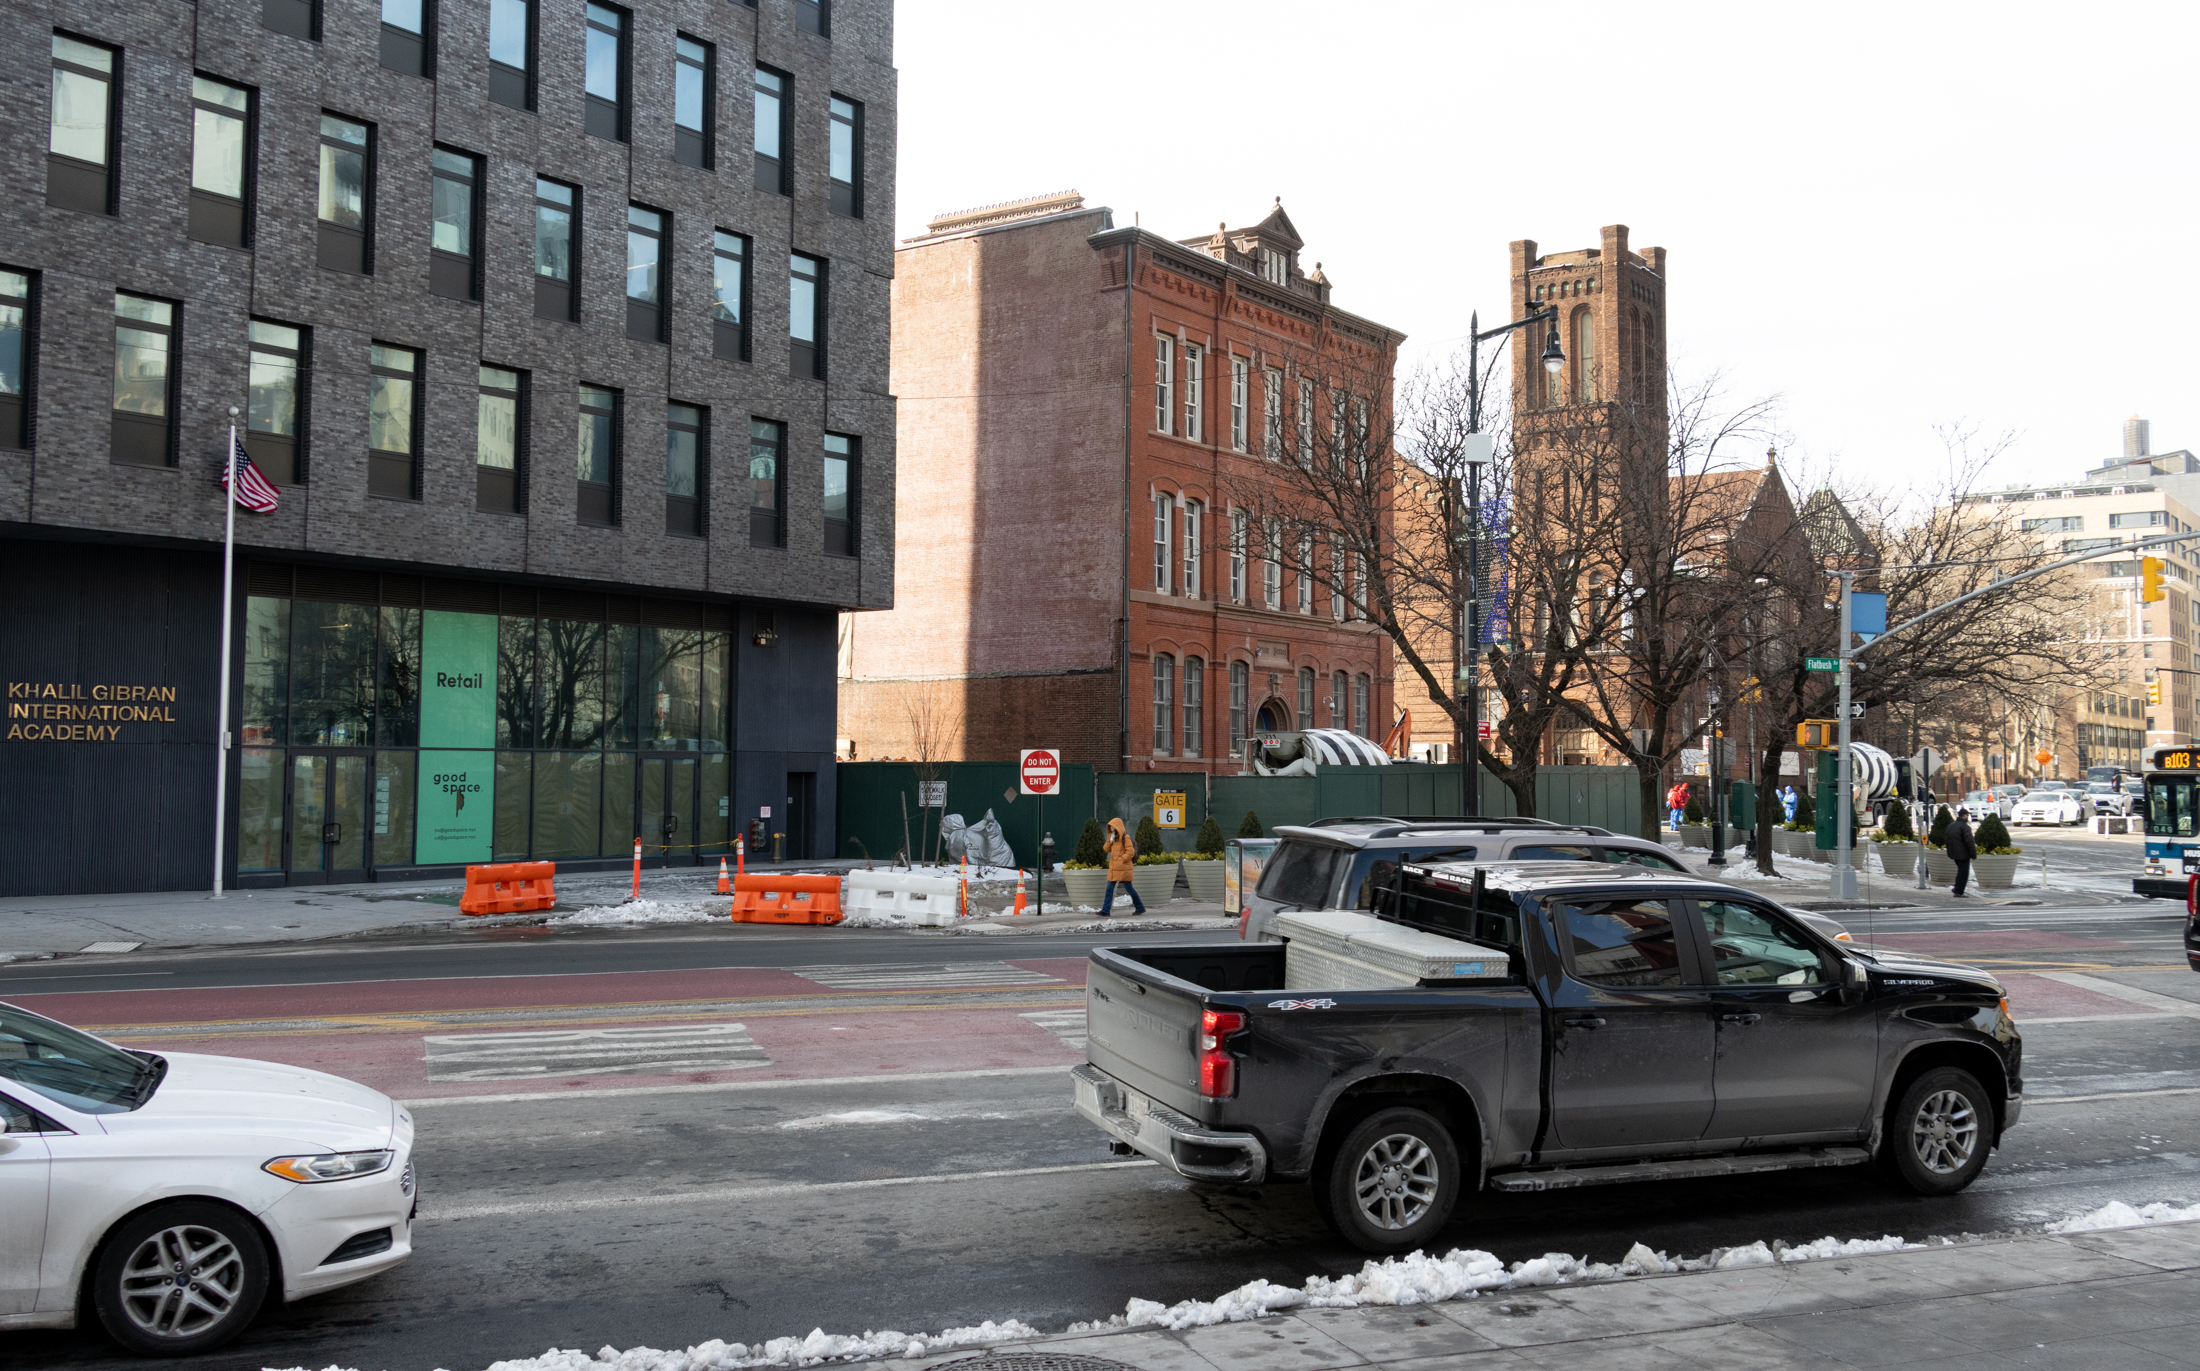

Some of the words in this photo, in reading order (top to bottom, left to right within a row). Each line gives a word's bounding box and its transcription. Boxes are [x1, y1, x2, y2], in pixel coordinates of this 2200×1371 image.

[1808, 659, 1832, 669] Flatbush
[437, 672, 482, 689] Retail
[8, 682, 89, 699] KHALIL
[92, 685, 176, 702] GIBRAN
[8, 703, 176, 722] INTERNATIONAL
[7, 723, 121, 741] ACADEMY
[2164, 752, 2190, 768] B103
[433, 772, 467, 785] good
[1156, 796, 1183, 806] GATE
[1166, 811, 1173, 823] 6
